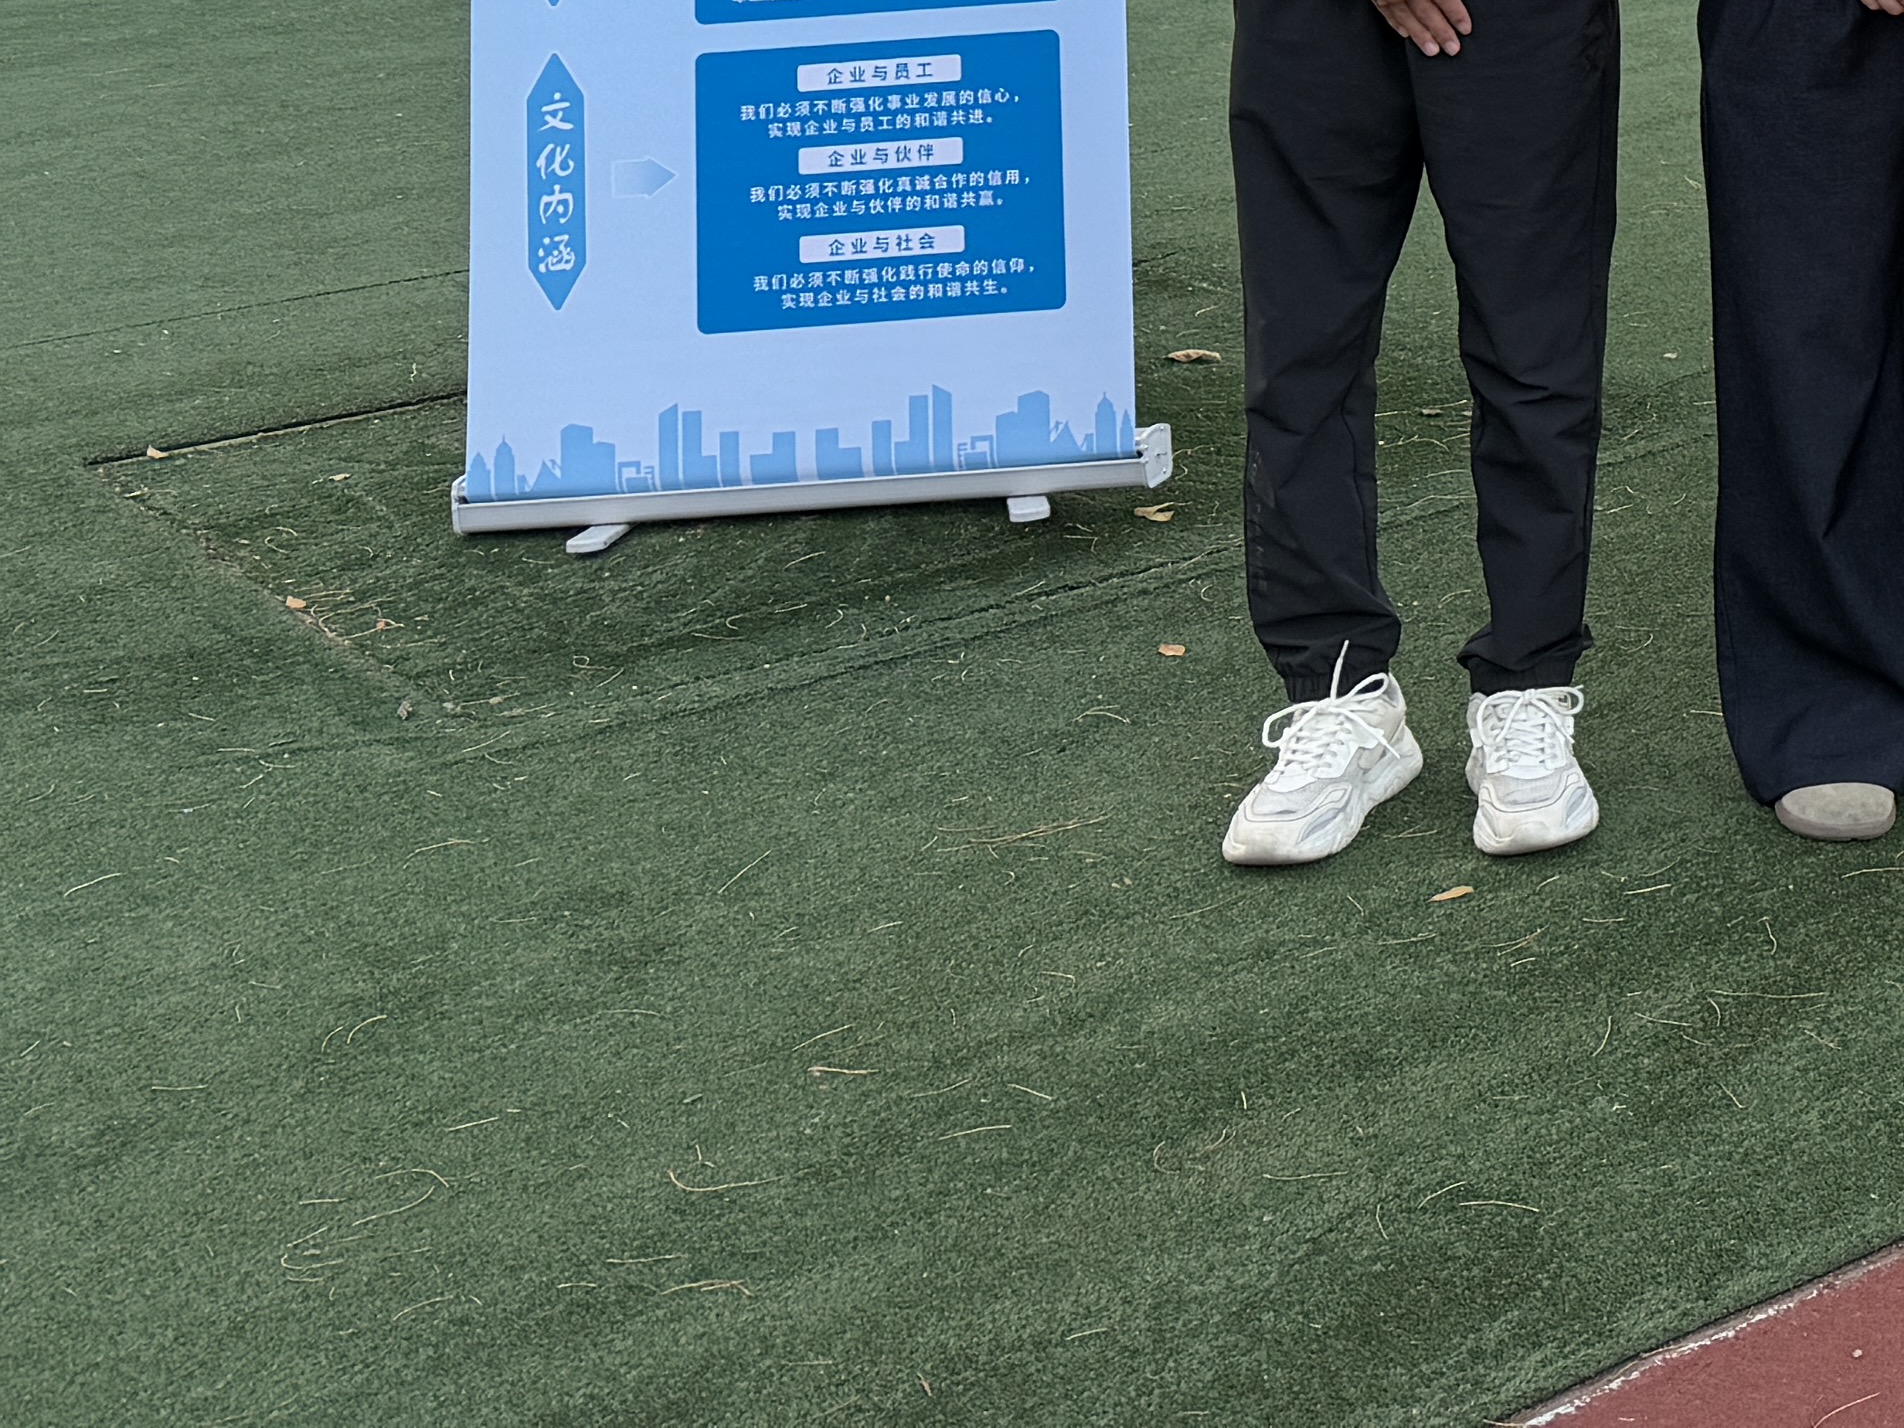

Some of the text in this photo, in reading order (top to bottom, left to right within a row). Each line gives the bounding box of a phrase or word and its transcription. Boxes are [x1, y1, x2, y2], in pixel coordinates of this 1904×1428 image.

[826, 61, 935, 86] 企业与员工
[740, 87, 1020, 121] 我们必须不断强化事业发展的信心，
[768, 109, 993, 138] 实现企业与员工的和谐共进。
[827, 143, 935, 168] 企业与伙伴
[534, 91, 578, 275] 文化内涵
[777, 190, 1004, 221] 实现企业与伙伴的和谐共赢。
[828, 232, 936, 257] 企业与社会
[781, 279, 1008, 309] 实现企业与社会的和谐共生。
